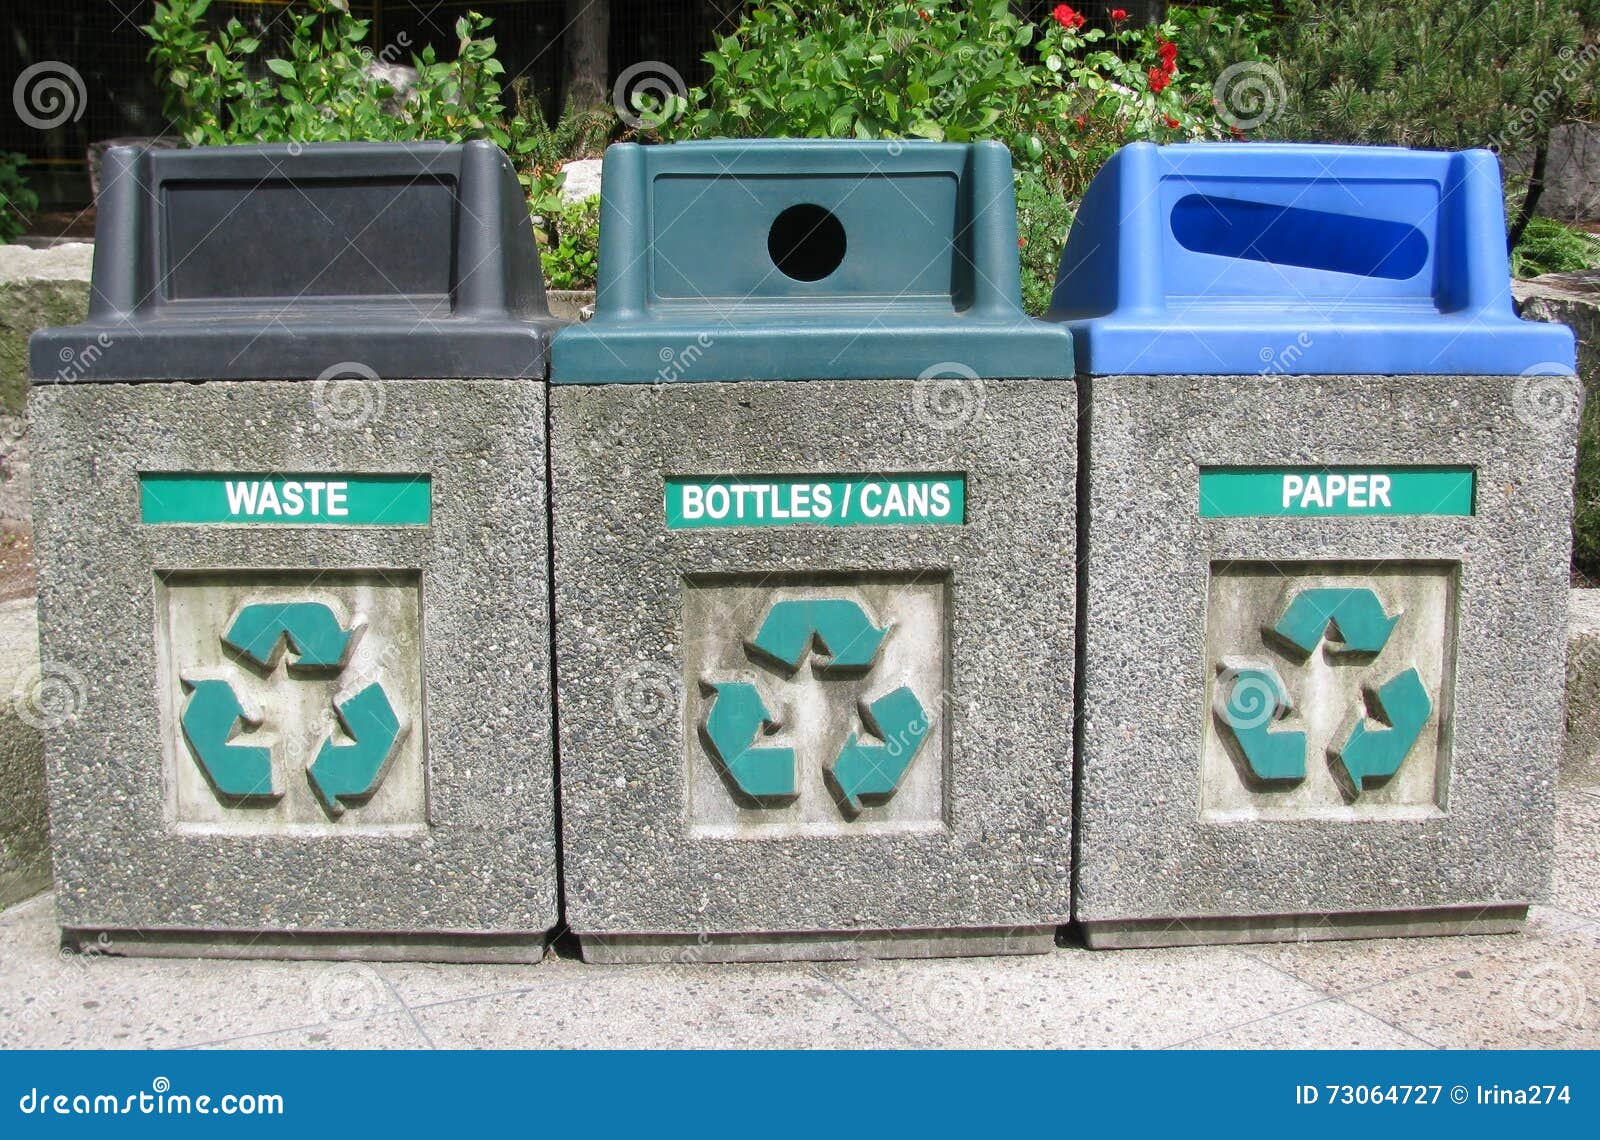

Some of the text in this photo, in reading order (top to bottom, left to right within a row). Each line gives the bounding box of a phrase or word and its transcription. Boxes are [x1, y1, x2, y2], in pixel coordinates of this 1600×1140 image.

[225, 481, 349, 516] WASTE
[682, 482, 951, 519] BOTTLES / CANS
[1282, 474, 1391, 508] PAPER
